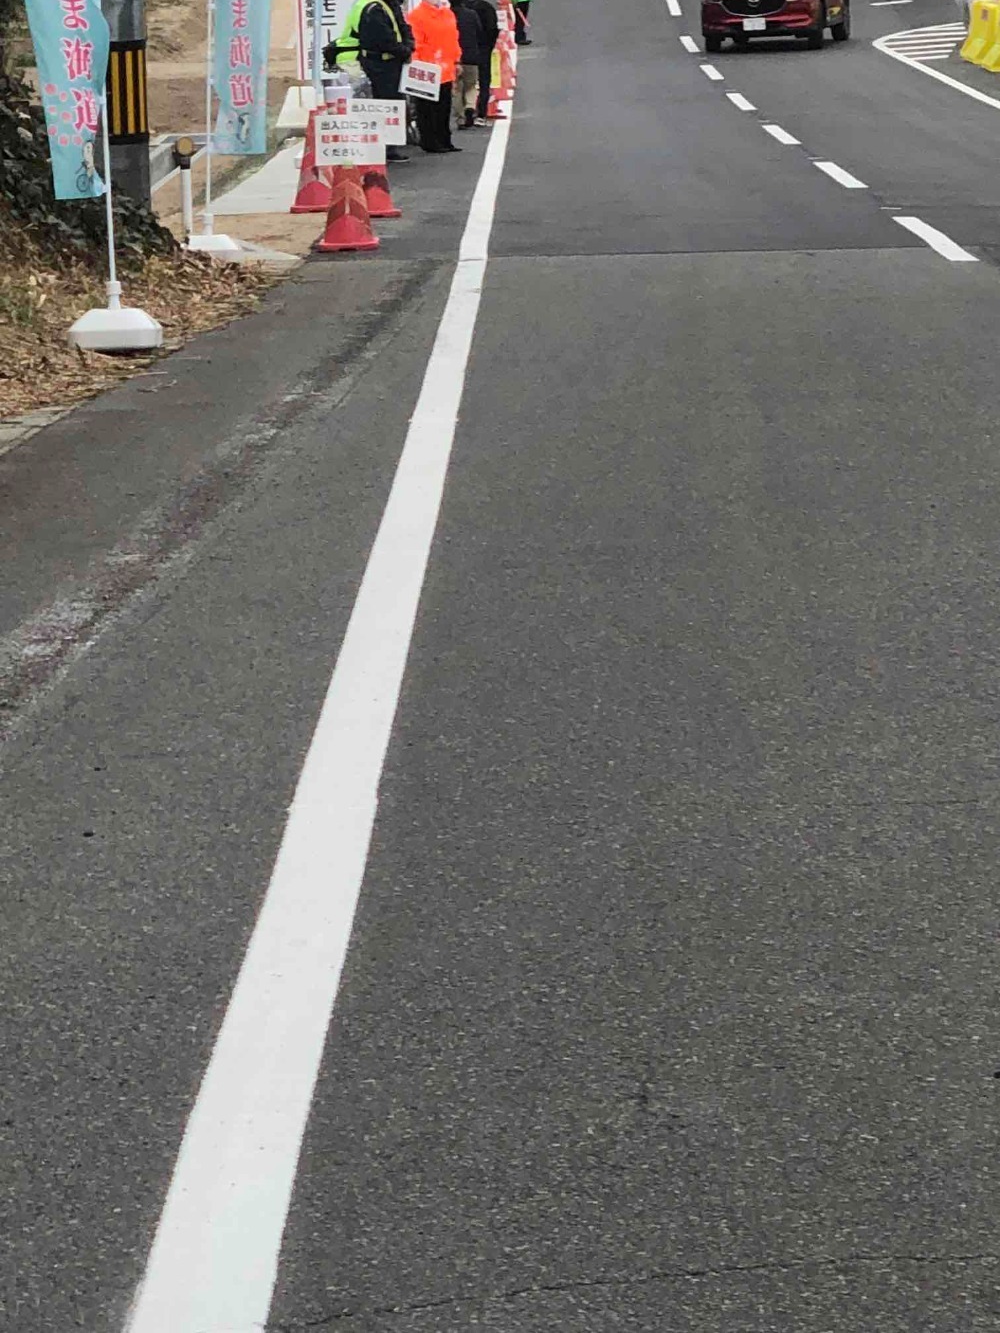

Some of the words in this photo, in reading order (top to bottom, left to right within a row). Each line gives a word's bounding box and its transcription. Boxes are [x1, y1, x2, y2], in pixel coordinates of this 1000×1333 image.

[321, 120, 378, 130] 出入口につき
